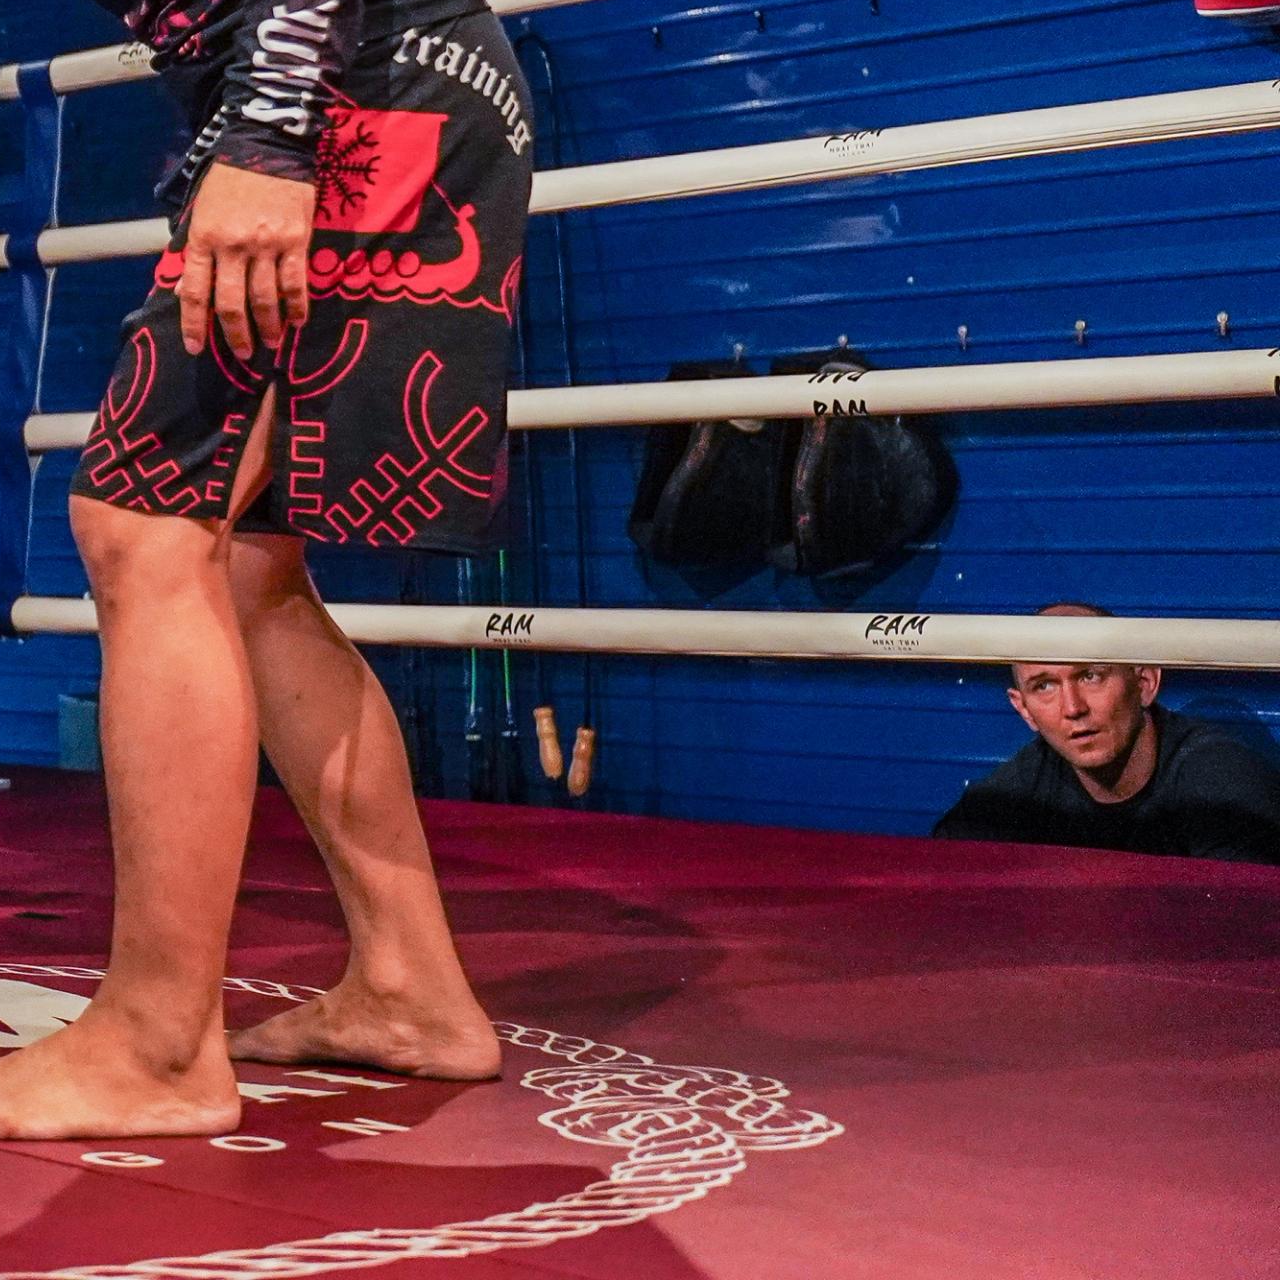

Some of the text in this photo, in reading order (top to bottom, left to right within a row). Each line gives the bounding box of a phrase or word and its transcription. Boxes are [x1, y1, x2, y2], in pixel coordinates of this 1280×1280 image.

[392, 27, 532, 156] training
[485, 612, 535, 638] RAM
[865, 614, 931, 640] RAM
